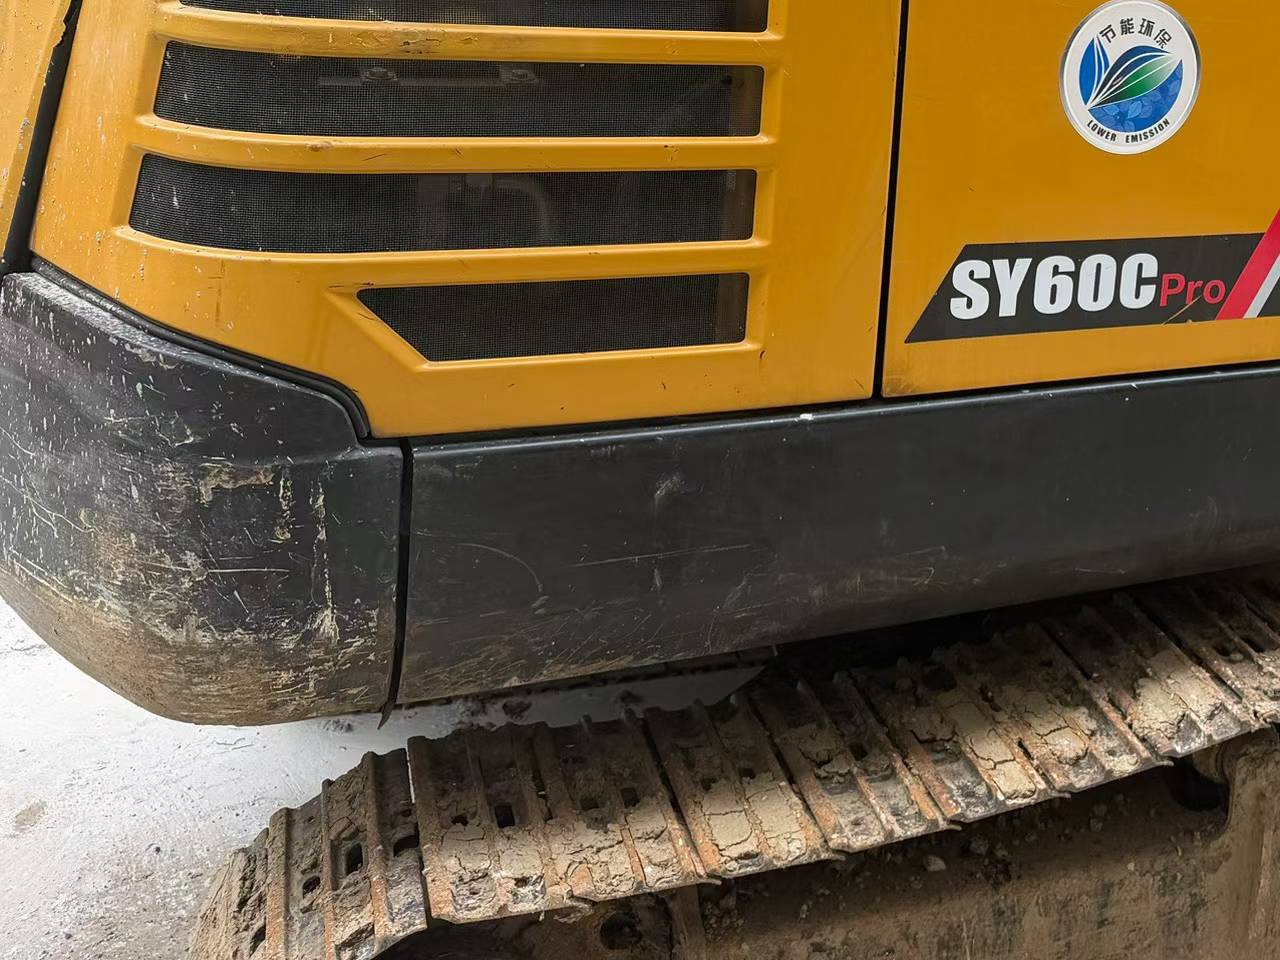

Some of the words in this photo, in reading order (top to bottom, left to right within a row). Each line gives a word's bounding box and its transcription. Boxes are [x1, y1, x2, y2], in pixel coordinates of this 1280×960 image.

[1099, 17, 1173, 49] 节能环保
[1087, 119, 1117, 142] LOWER
[1125, 118, 1171, 144] EMISSION
